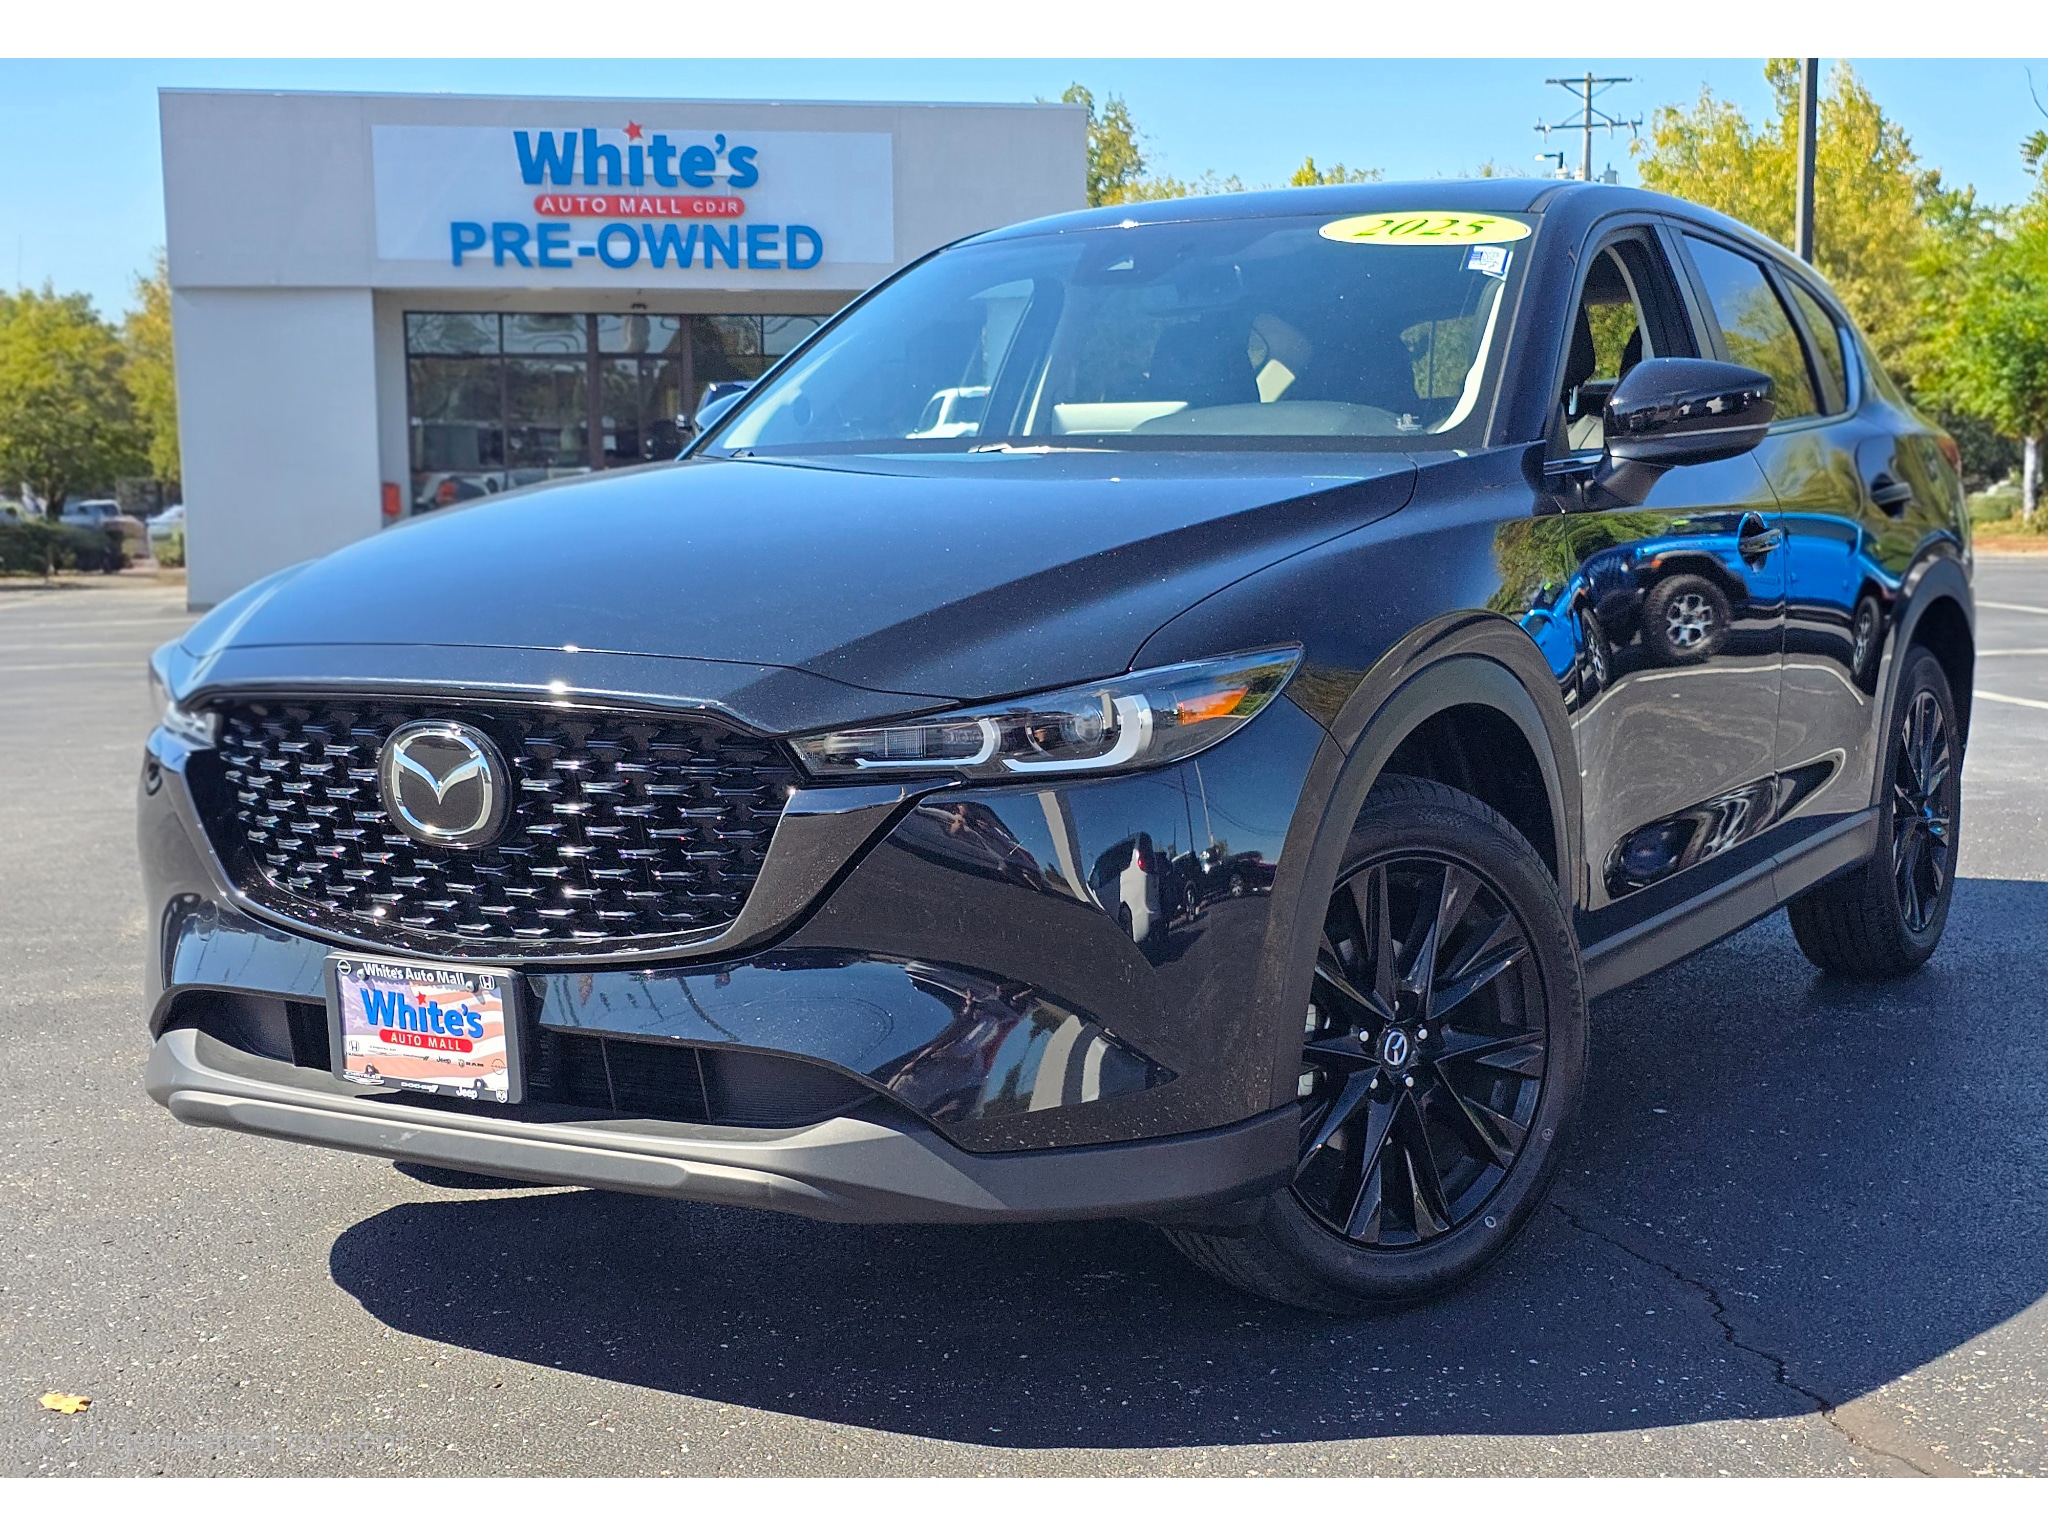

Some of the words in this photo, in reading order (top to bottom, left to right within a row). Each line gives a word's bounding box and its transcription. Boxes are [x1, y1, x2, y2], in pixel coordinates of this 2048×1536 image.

[513, 125, 759, 188] White's
[541, 197, 608, 214] AUTO
[619, 199, 682, 214] MALL
[692, 201, 739, 214] CDJR
[1352, 218, 1497, 237] 2025
[450, 221, 823, 269] PRE-OWNED
[362, 962, 403, 981] White's
[405, 968, 434, 982] Auto
[436, 971, 465, 985] Mall
[360, 988, 483, 1038] White's
[390, 1032, 421, 1046] AUTO
[428, 1036, 461, 1051] MALL
[436, 1056, 452, 1065] Jeep
[456, 1087, 478, 1100] Jeep
